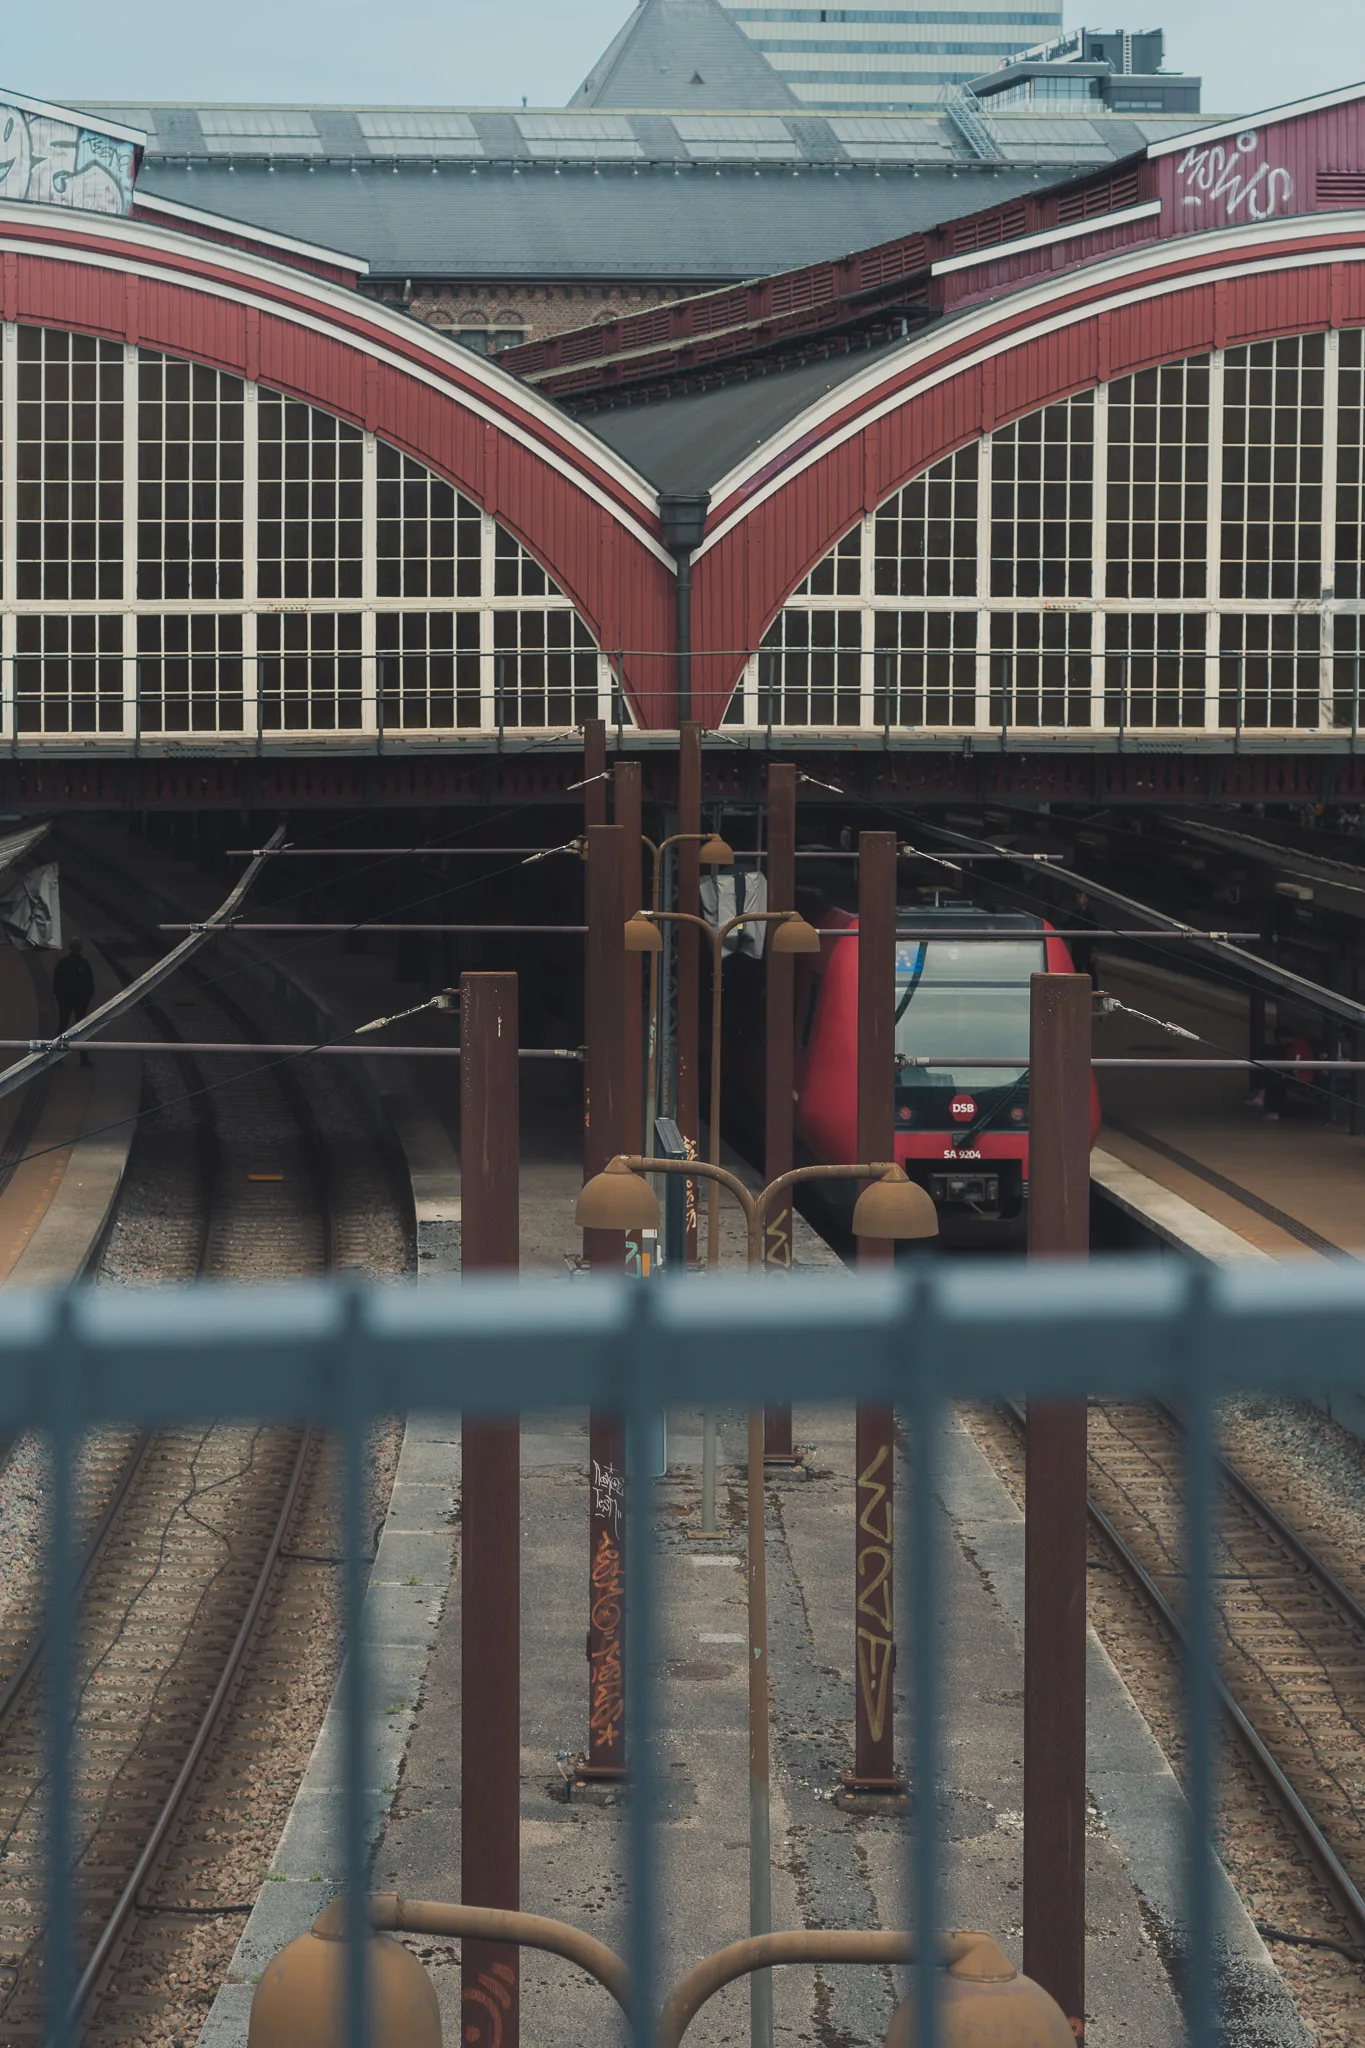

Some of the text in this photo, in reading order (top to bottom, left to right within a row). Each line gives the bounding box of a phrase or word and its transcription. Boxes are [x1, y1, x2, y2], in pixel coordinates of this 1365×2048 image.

[952, 1103, 974, 1113] DSB
[943, 1149, 981, 1159] SA 9204
